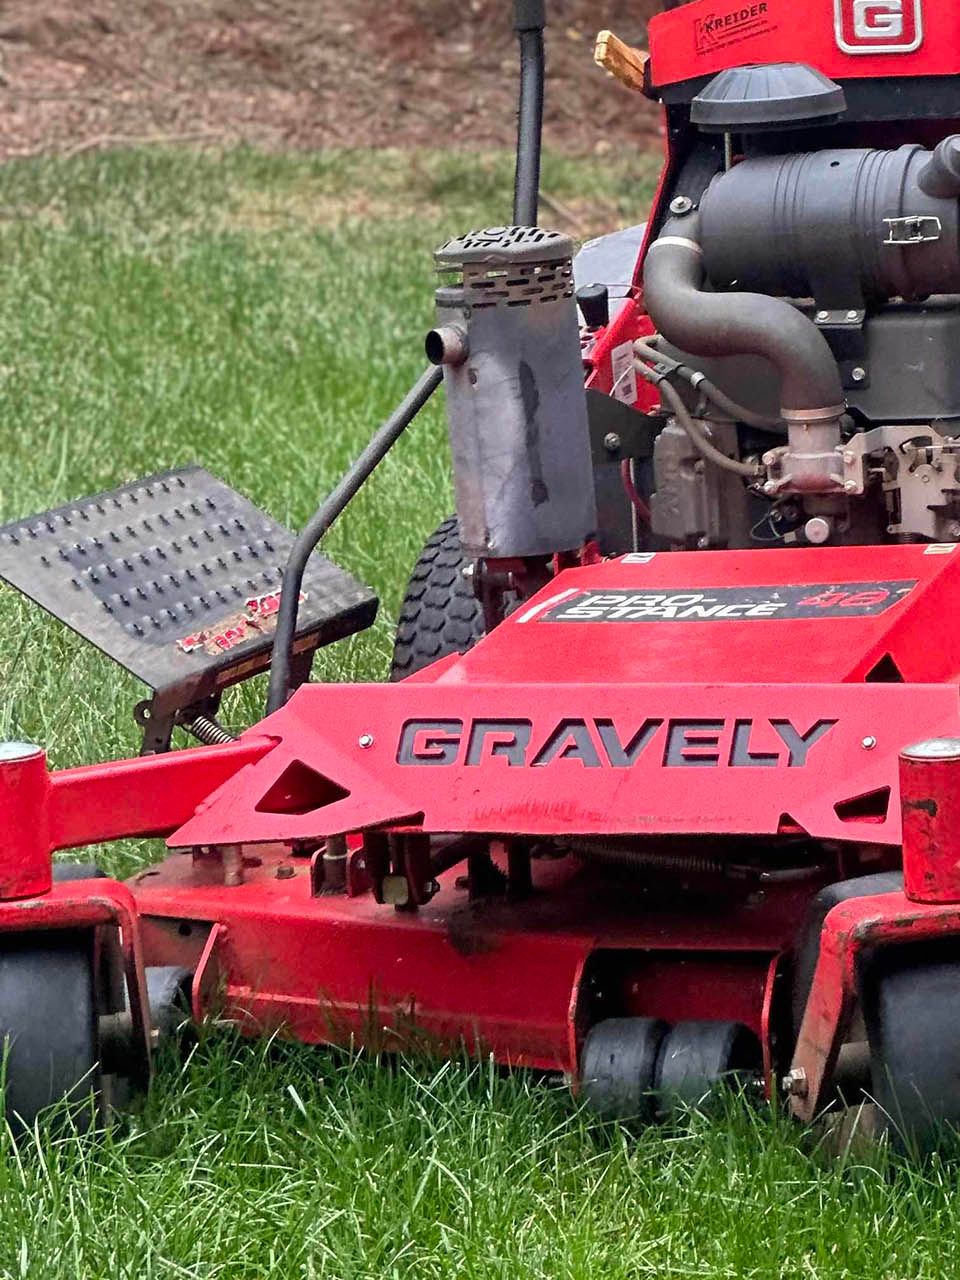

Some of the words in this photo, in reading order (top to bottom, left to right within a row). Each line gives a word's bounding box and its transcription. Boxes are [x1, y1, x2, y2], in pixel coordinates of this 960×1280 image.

[703, 2, 768, 33] KREIDER
[555, 602, 788, 619] STANCE
[576, 593, 718, 608] PRO-
[395, 718, 840, 768] GRAVELY
